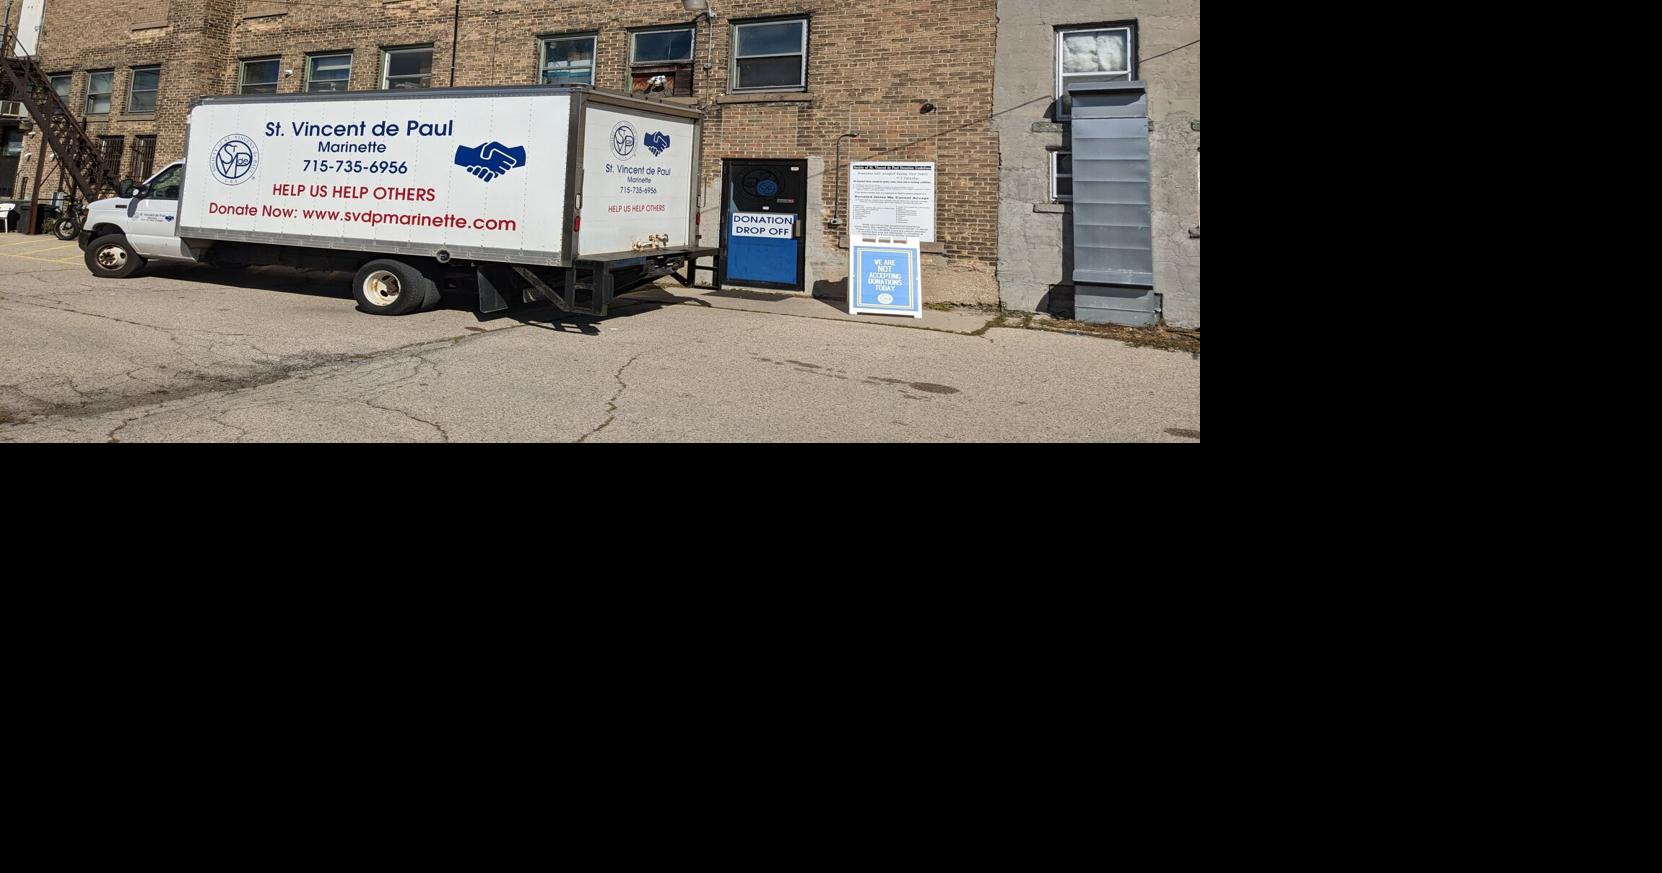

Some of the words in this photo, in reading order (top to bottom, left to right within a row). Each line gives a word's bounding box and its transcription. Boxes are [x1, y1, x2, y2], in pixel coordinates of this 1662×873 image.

[265, 121, 285, 137] St.
[292, 121, 366, 137] Vincent
[371, 121, 399, 137] de
[407, 120, 453, 137] Paul
[318, 141, 387, 153] Marinette
[303, 159, 408, 174] 715-735-6956
[605, 163, 615, 173] St.
[617, 164, 645, 175] Vincent
[646, 166, 656, 175] de
[657, 167, 671, 177] Paul
[627, 176, 652, 184] Marinette
[272, 183, 306, 197] HELP
[310, 184, 328, 198] US
[332, 185, 369, 199] HELP
[373, 187, 436, 202] OTHERS
[620, 186, 657, 194] 715-735-6956
[608, 205, 622, 213] HELP
[623, 205, 631, 213] US
[646, 204, 666, 212] OTHERS
[208, 202, 258, 217] Donate
[262, 205, 298, 219] Now:
[303, 209, 517, 231] www.svdpmarinette.com
[733, 215, 793, 225] DONATION
[736, 226, 766, 235] DROP
[769, 227, 790, 236] OFF
[874, 258, 883, 266] WE
[884, 259, 896, 267] ARE
[877, 265, 892, 273] NOT
[868, 272, 902, 280] ACCEPTING
[867, 278, 903, 287] DONATIONS
[875, 284, 896, 292] TODAY
